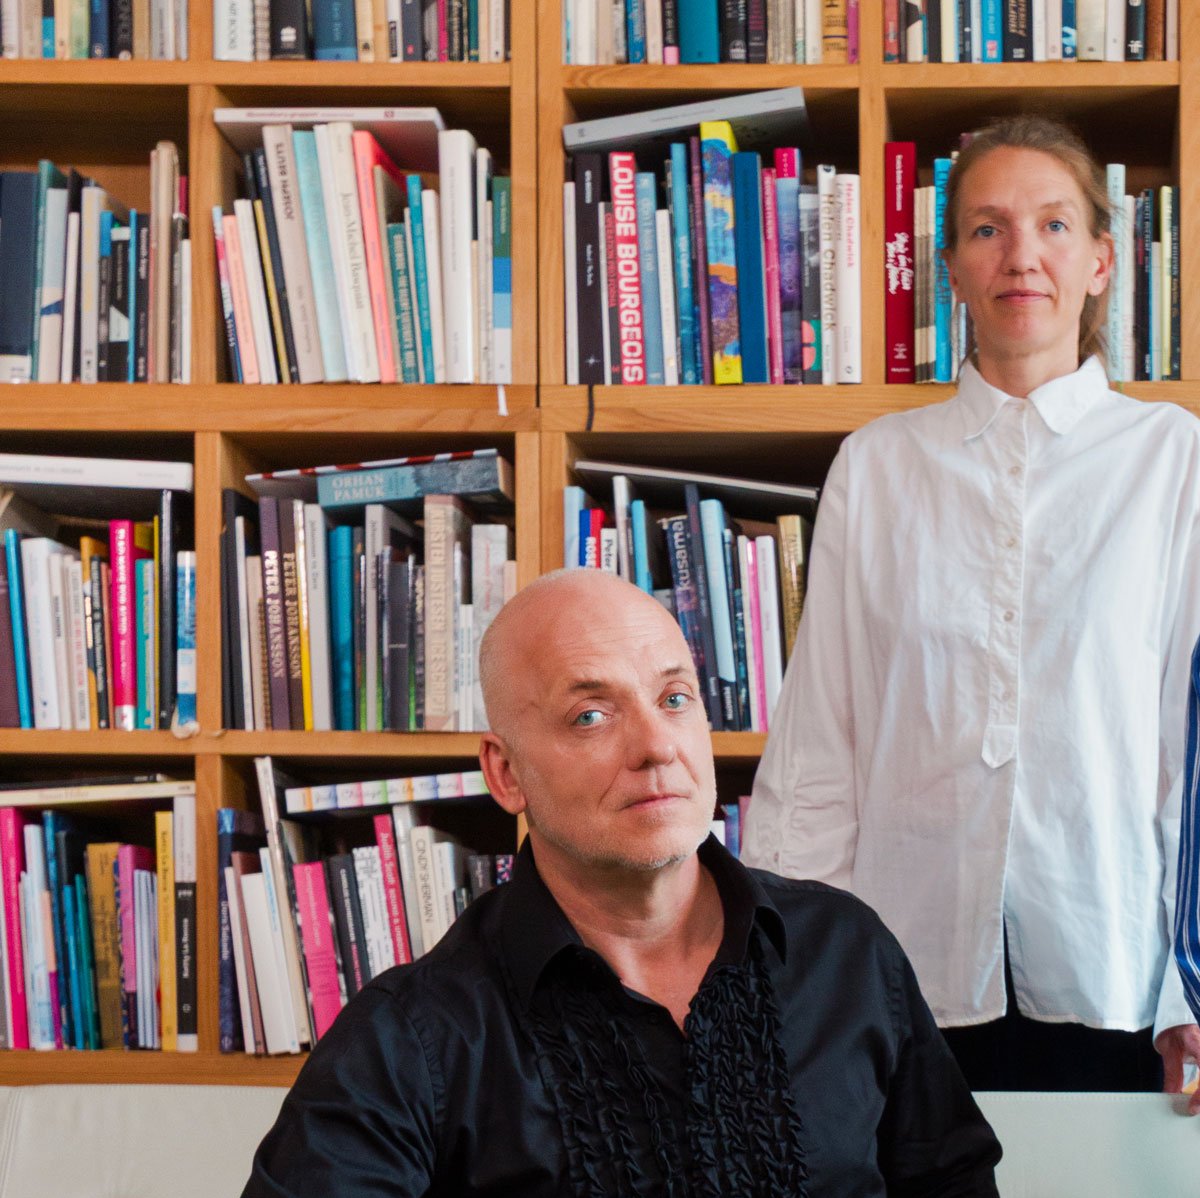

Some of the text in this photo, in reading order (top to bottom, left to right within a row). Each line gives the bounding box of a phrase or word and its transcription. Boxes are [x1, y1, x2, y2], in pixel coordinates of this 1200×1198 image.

[845, 182, 855, 268] Helen Chadwick
[613, 154, 644, 383] LOUISE BOURGEOIS
[821, 193, 837, 331] Helen Chadwick
[332, 471, 384, 502] ORHAN PAMUK
[430, 509, 447, 566] KIRSTEN
[604, 539, 614, 568] Peter
[671, 520, 691, 592] kusama
[264, 550, 284, 678] PETER JOHANSSON
[283, 552, 302, 680] PETER JOHANSSON
[380, 832, 395, 860] Judith
[415, 838, 428, 871] CINDY
